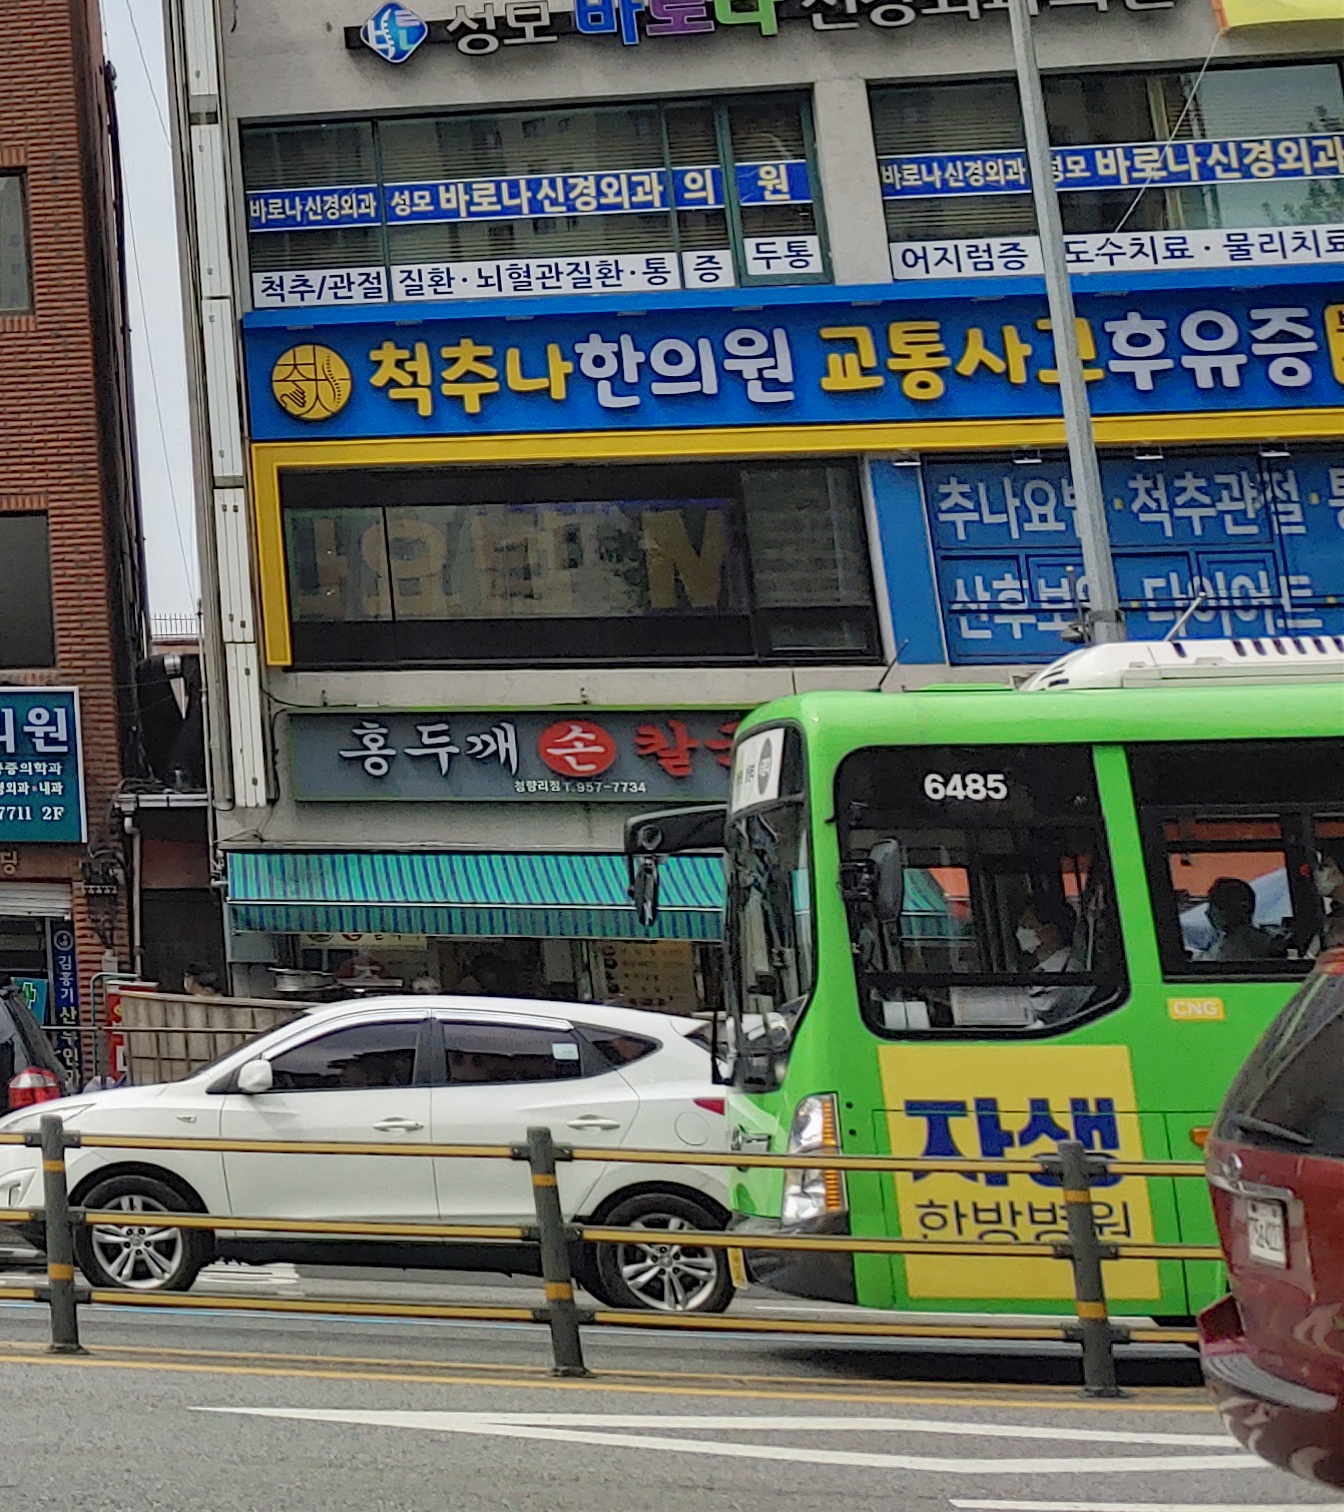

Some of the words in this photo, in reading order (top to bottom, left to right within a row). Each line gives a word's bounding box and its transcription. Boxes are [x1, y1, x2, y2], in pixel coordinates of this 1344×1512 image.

[445, 1, 559, 56] 성모
[391, 191, 434, 214] 성모
[260, 271, 383, 304] 척추/관절
[751, 238, 814, 271] 두통
[901, 242, 1029, 274] 어지럼증
[368, 327, 796, 417] 척추나한의원
[937, 476, 1078, 541] 추나요
[339, 720, 519, 777] 홍두깨
[546, 725, 605, 772] 손
[41, 806, 64, 820] 2F
[923, 773, 1008, 800] 6485
[1173, 1000, 1219, 1017] CNG
[903, 1097, 1124, 1188] 자생
